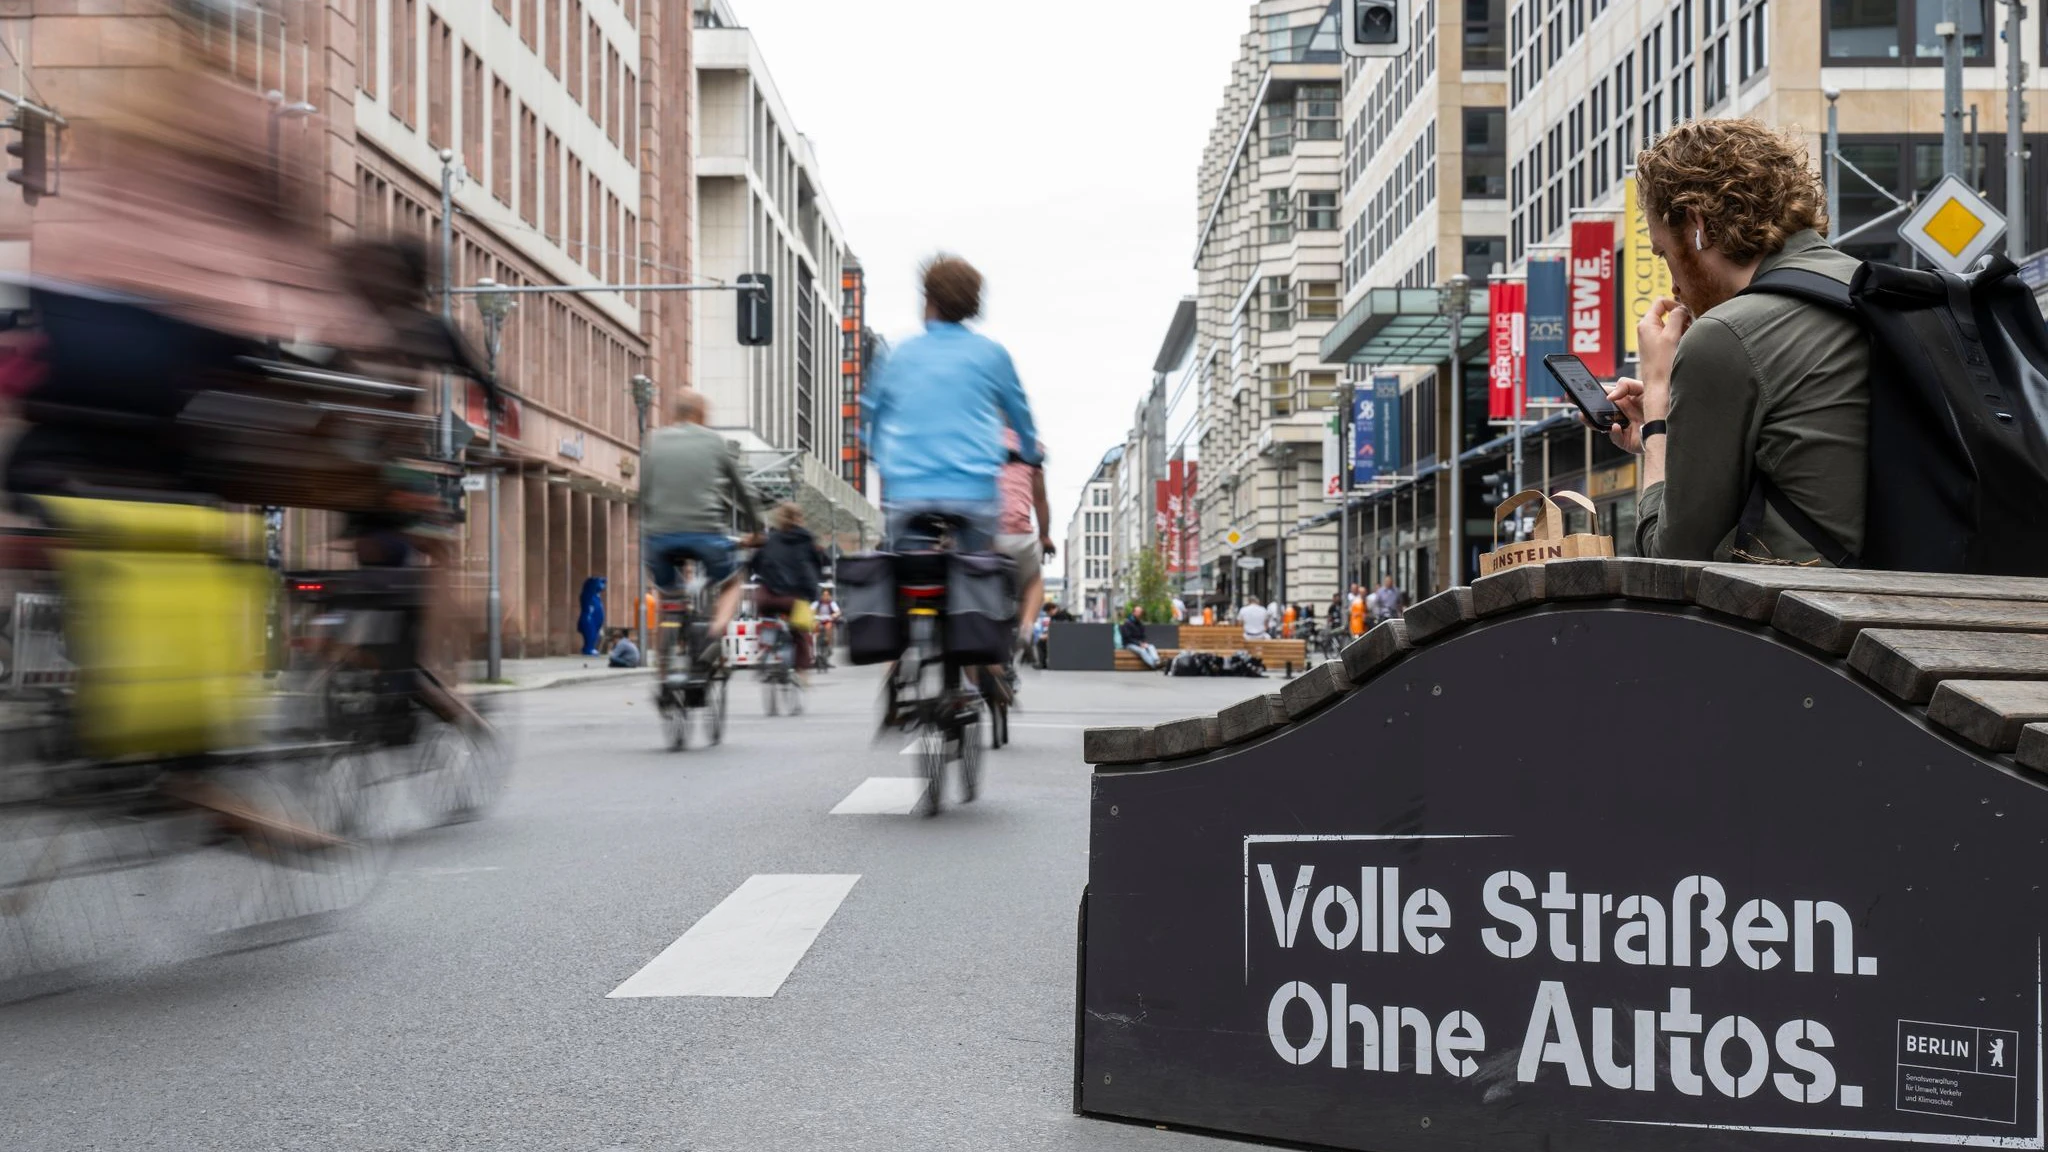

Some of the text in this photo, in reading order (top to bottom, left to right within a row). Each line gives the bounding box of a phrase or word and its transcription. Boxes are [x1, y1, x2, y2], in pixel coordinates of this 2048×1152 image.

[1600, 248, 1612, 280] CITY
[1573, 257, 1600, 353] REWE
[1530, 323, 1563, 338] 205
[1492, 313, 1512, 389] DERTOUR
[1258, 863, 1878, 976] Volle Straßen.
[1268, 980, 1864, 1108] Ohne Autos.
[1906, 1035, 1969, 1058] BERLIN
[1905, 1073, 1959, 1087] Senatsverwaltung
[1905, 1083, 1962, 1097] für Umwelt, Verkehr
[1918, 1096, 1954, 1107] Klimaschutz
